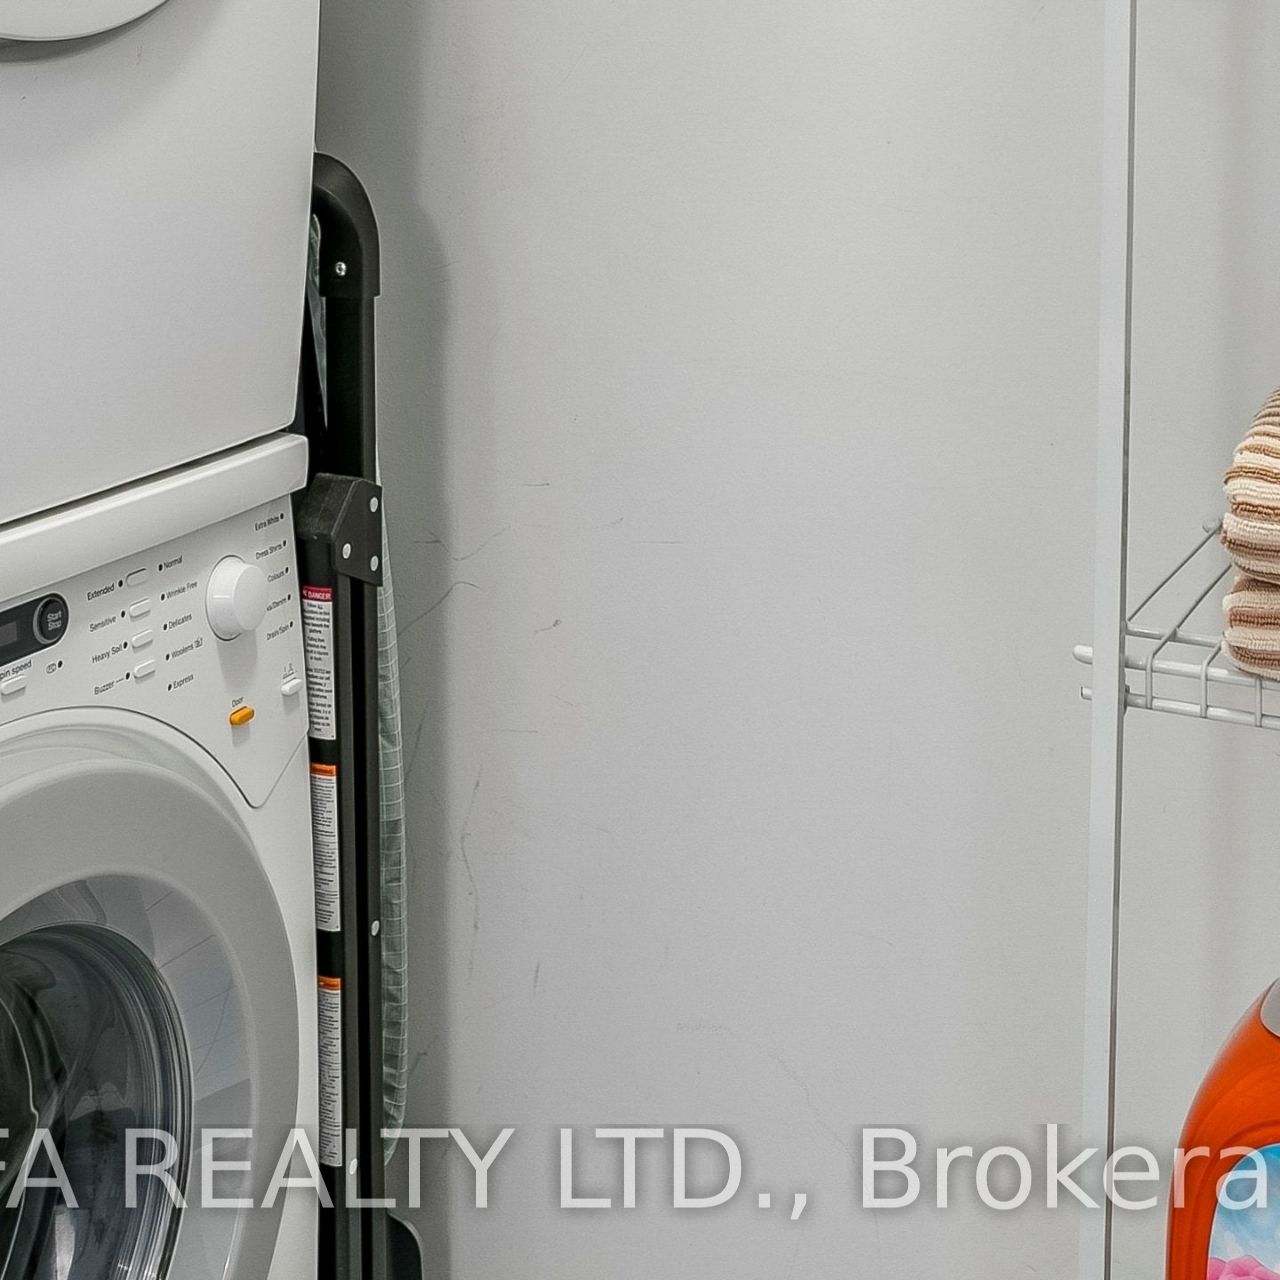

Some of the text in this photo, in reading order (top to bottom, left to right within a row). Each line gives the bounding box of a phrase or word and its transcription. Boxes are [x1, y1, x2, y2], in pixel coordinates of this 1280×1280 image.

[87, 583, 115, 601] Extended
[89, 616, 117, 632] Sensitive
[168, 613, 192, 629] Delicates
[92, 650, 110, 663] Heavy
[11, 660, 32, 676] speed
[94, 680, 115, 695] Buzzer
[173, 674, 194, 689] Express
